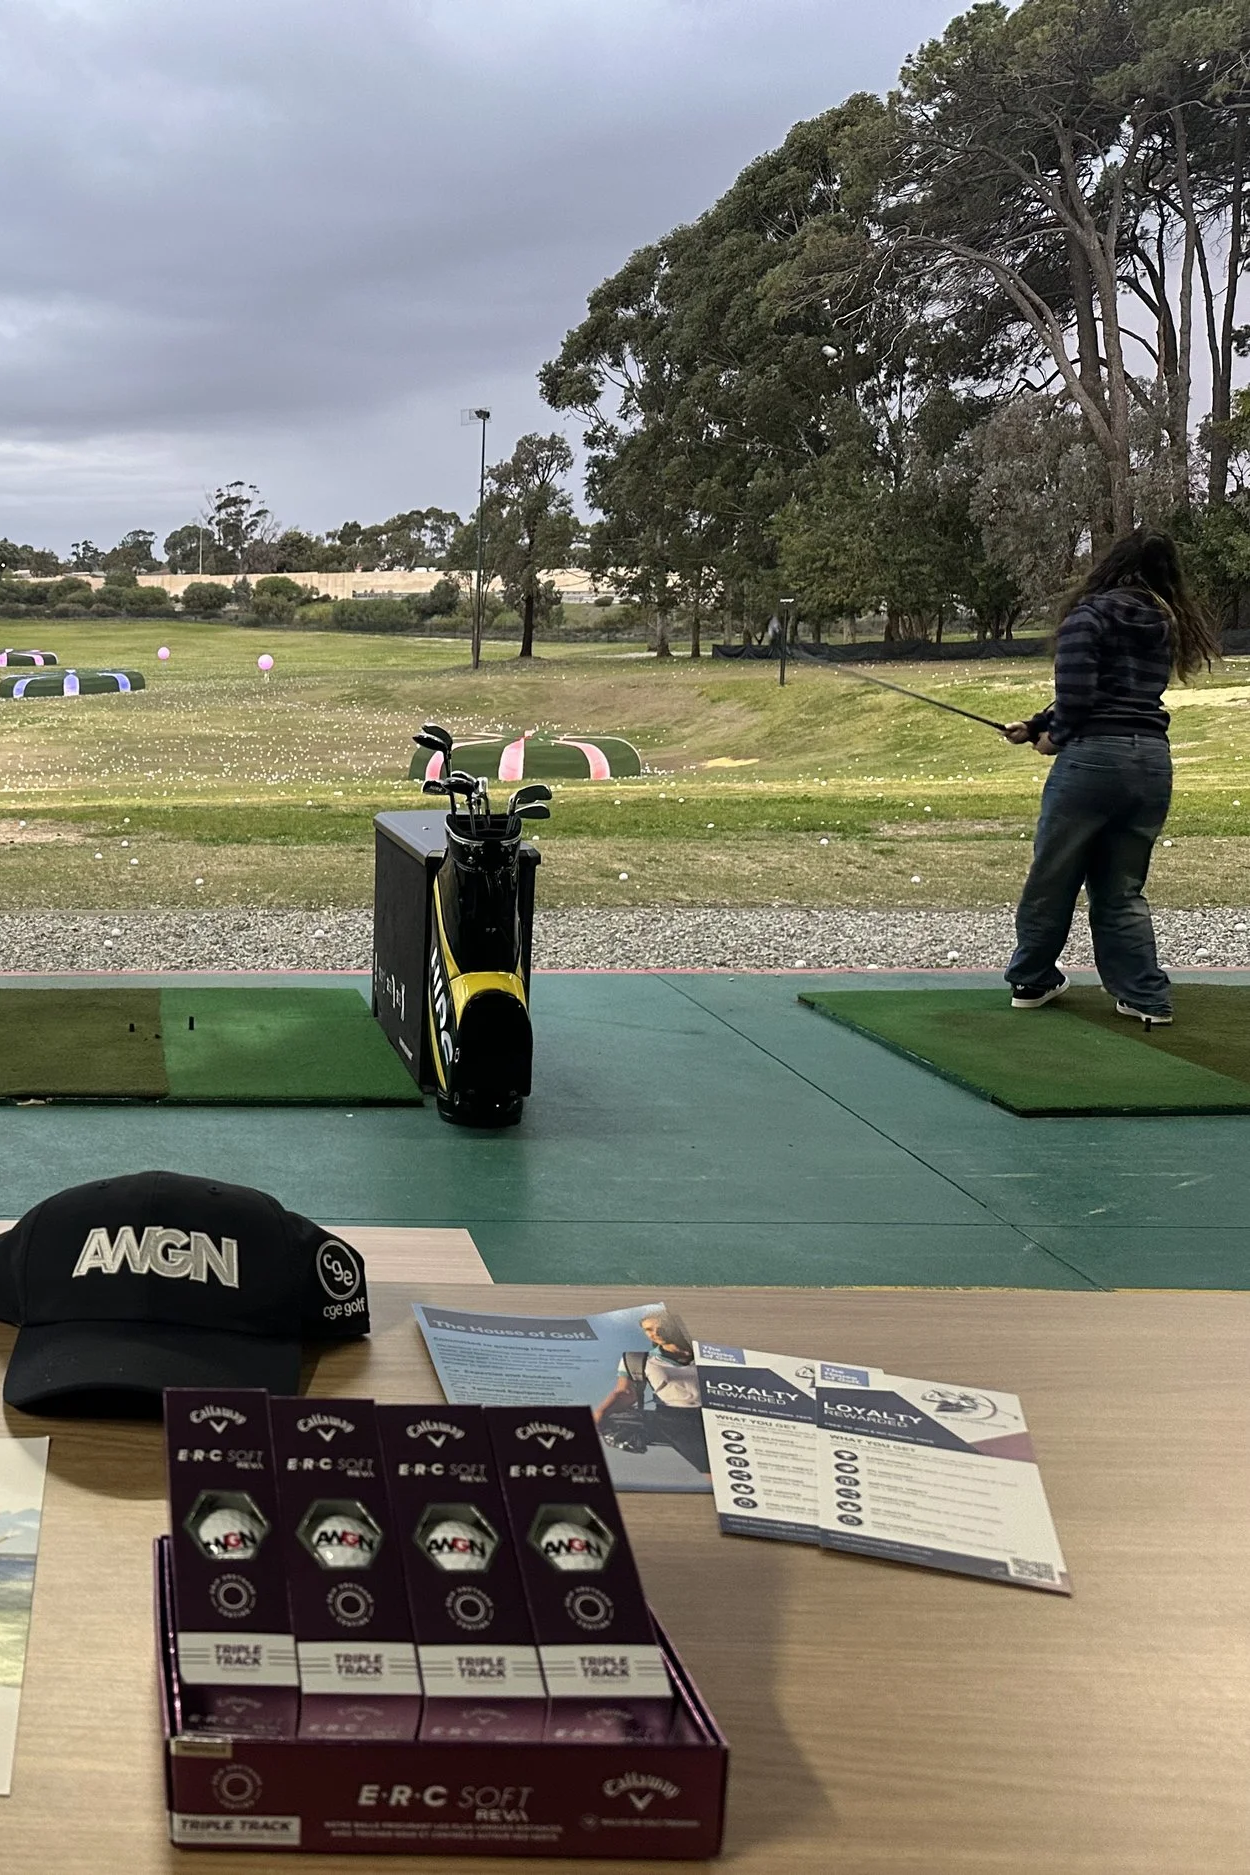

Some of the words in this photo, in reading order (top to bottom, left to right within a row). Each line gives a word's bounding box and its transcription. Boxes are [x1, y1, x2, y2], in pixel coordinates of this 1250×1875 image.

[71, 1225, 239, 1289] AWGN
[323, 1252, 354, 1288] cge
[323, 1304, 342, 1321] cge
[344, 1297, 366, 1318] golf
[432, 1319, 466, 1331] The
[470, 1326, 524, 1337] House
[528, 1330, 546, 1338] of
[550, 1331, 592, 1341] Golf.
[702, 1344, 721, 1352] The
[706, 1380, 799, 1401] LOYALTY
[707, 1388, 786, 1406] REWARDED
[189, 1404, 247, 1425] Callaway
[715, 1414, 746, 1423] WHAT
[750, 1419, 772, 1427] YOU
[824, 1401, 923, 1424] LOYALTY
[824, 1409, 908, 1428] REWARDED
[297, 1413, 355, 1434] Callaway
[406, 1420, 466, 1440] Callaway
[515, 1421, 575, 1441] Callaway
[830, 1434, 863, 1444] WHAT
[865, 1439, 891, 1449] YOU
[893, 1444, 916, 1453] GET
[227, 1450, 264, 1463] SOFT
[337, 1458, 374, 1471] SOFT
[449, 1464, 486, 1476] SOFT
[560, 1464, 598, 1476] SOFT
[316, 1530, 374, 1551] AWGN
[426, 1537, 486, 1559] AWGN
[544, 1537, 602, 1559] AWGN
[215, 1644, 262, 1655] TRIPLE
[335, 1653, 383, 1664] TRIPLE
[216, 1656, 262, 1666] TRACK
[337, 1665, 383, 1675] TRACK
[456, 1656, 506, 1667] TRIPLE
[579, 1656, 628, 1667] TRIPLE
[459, 1668, 506, 1678] TRACK
[582, 1667, 630, 1677] TRACK
[602, 1771, 680, 1799] Callaway
[457, 1786, 534, 1809] SOFT
[474, 1808, 529, 1822] REVA
[181, 1819, 234, 1831] TRIPLE
[241, 1820, 292, 1832] TRACK
